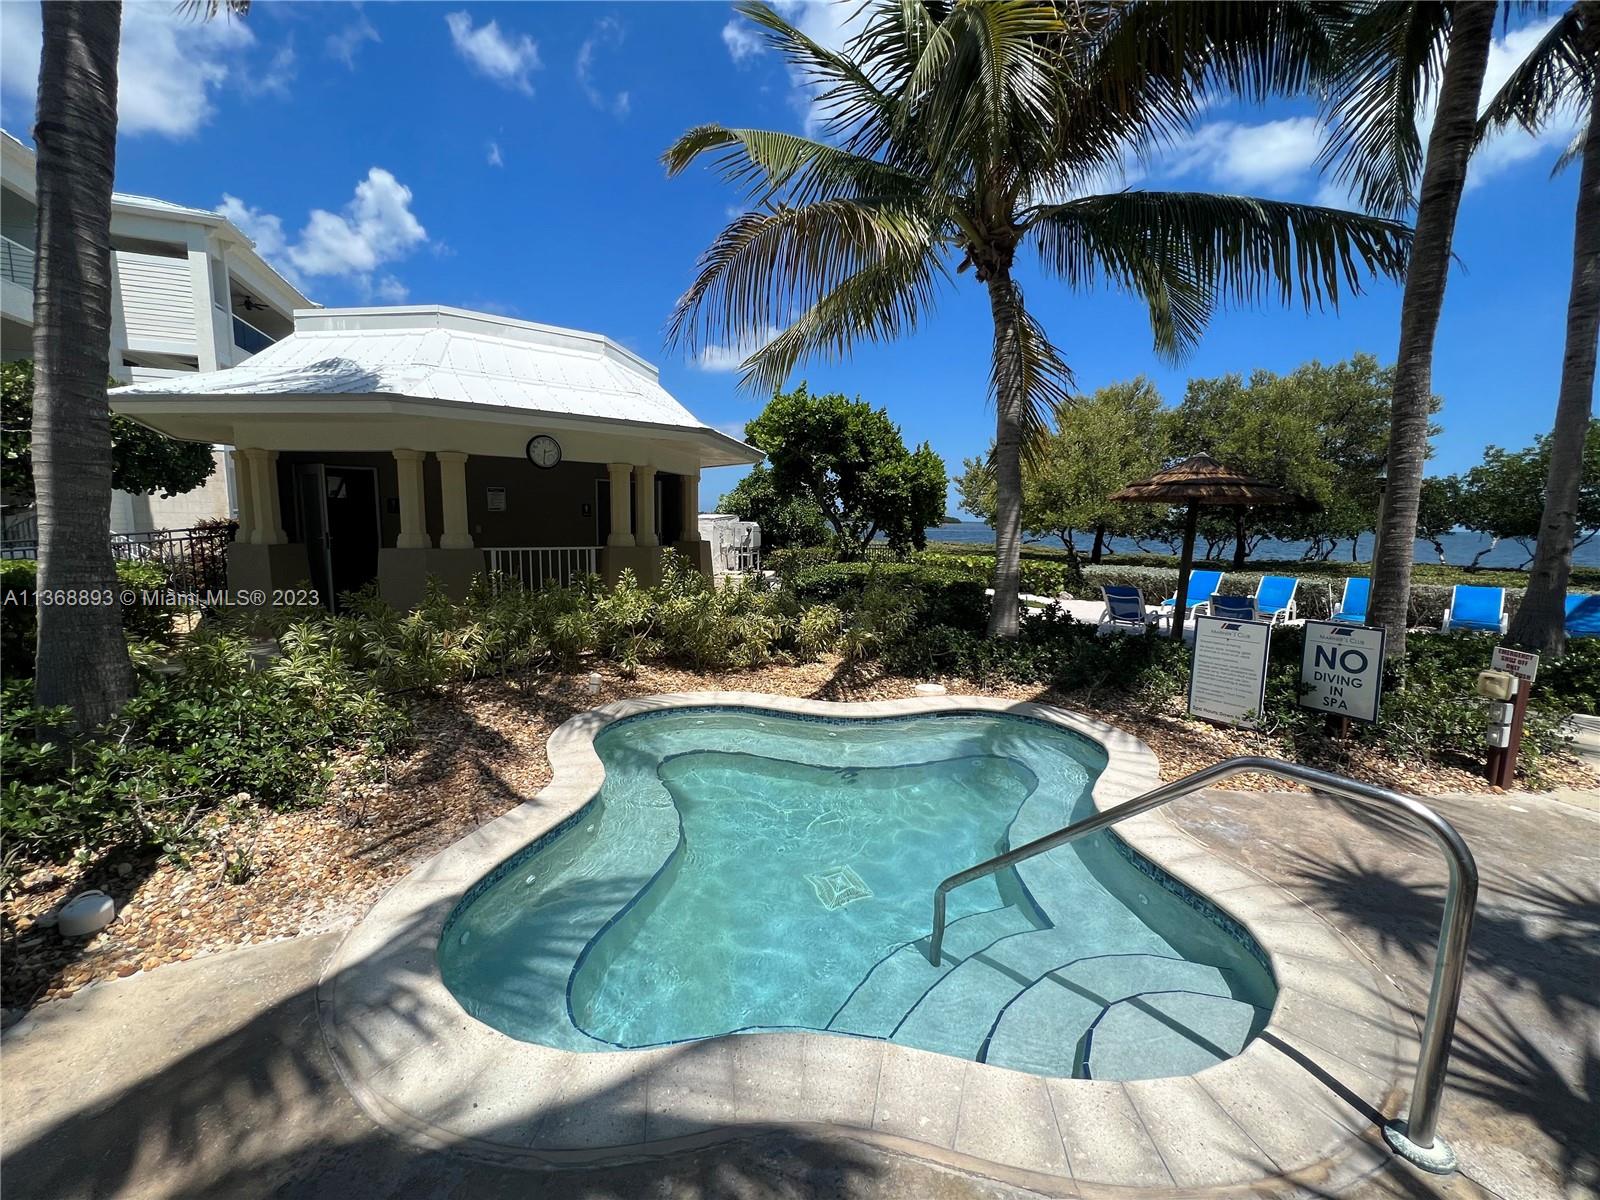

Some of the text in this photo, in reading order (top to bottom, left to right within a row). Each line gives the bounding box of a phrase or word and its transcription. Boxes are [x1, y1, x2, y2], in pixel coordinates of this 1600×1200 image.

[1314, 645, 1368, 674] NO
[1314, 671, 1363, 689] DIVING
[1329, 685, 1344, 698] IN
[1322, 696, 1348, 711] SPA
